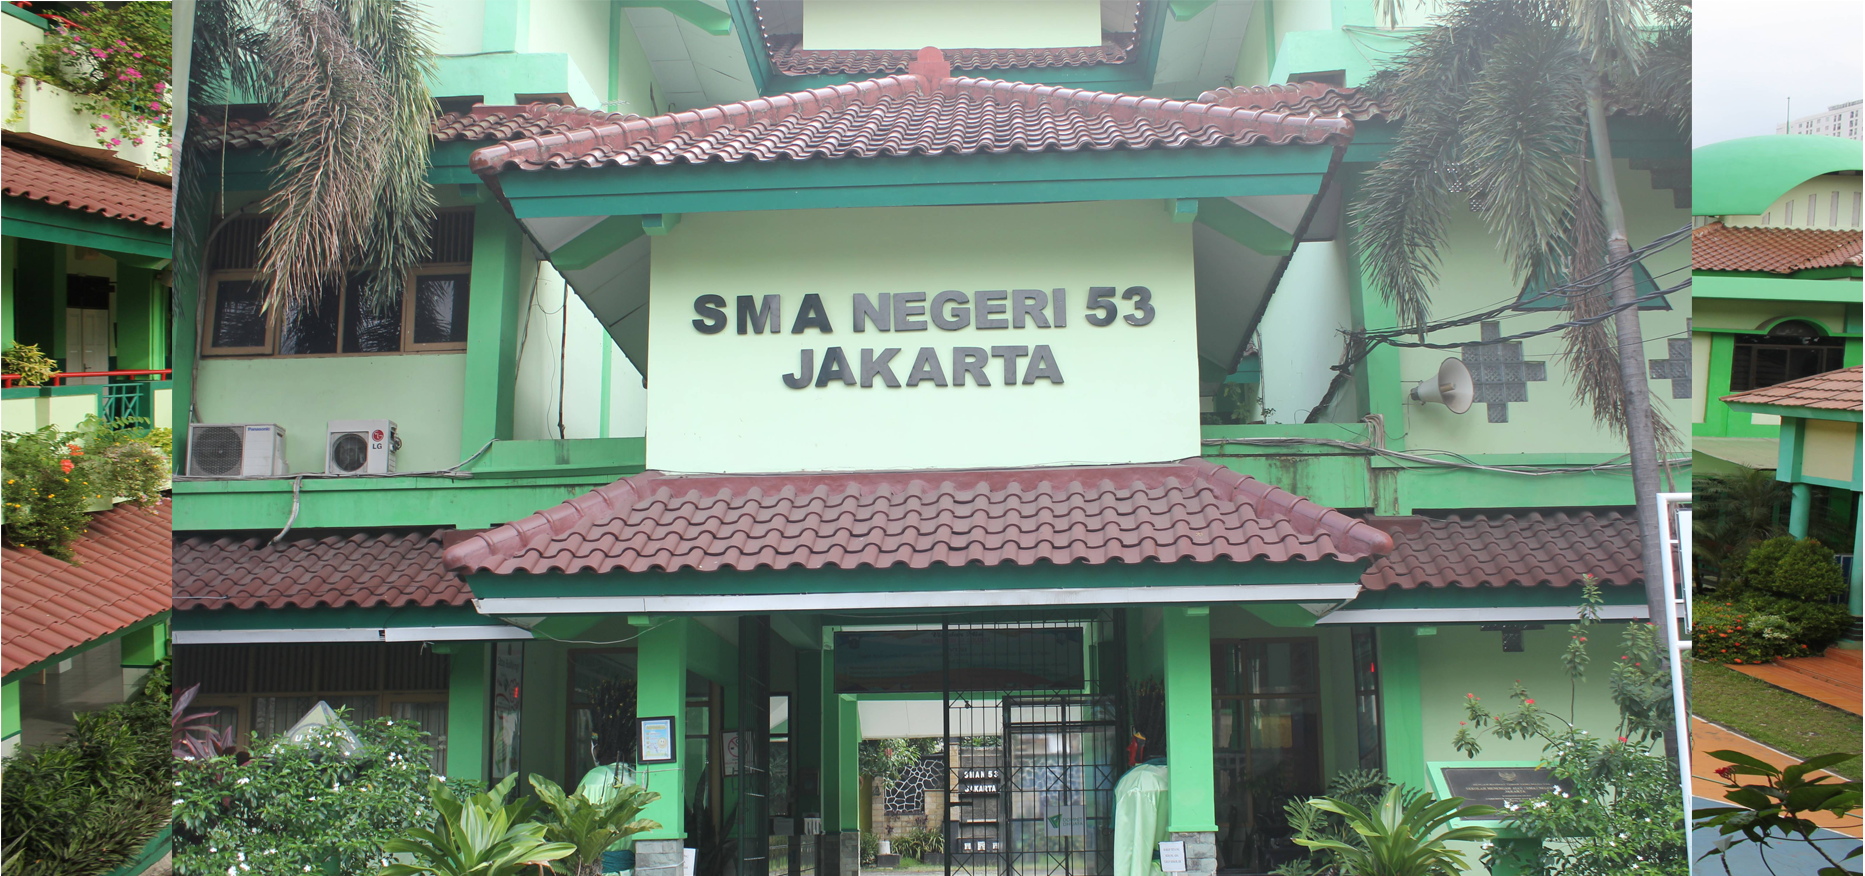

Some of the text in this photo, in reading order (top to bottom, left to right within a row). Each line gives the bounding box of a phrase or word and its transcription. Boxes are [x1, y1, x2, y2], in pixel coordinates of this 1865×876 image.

[692, 286, 1156, 335] SMA NEGERI 53
[782, 345, 1065, 389] JAKARTA
[987, 770, 999, 779] 53
